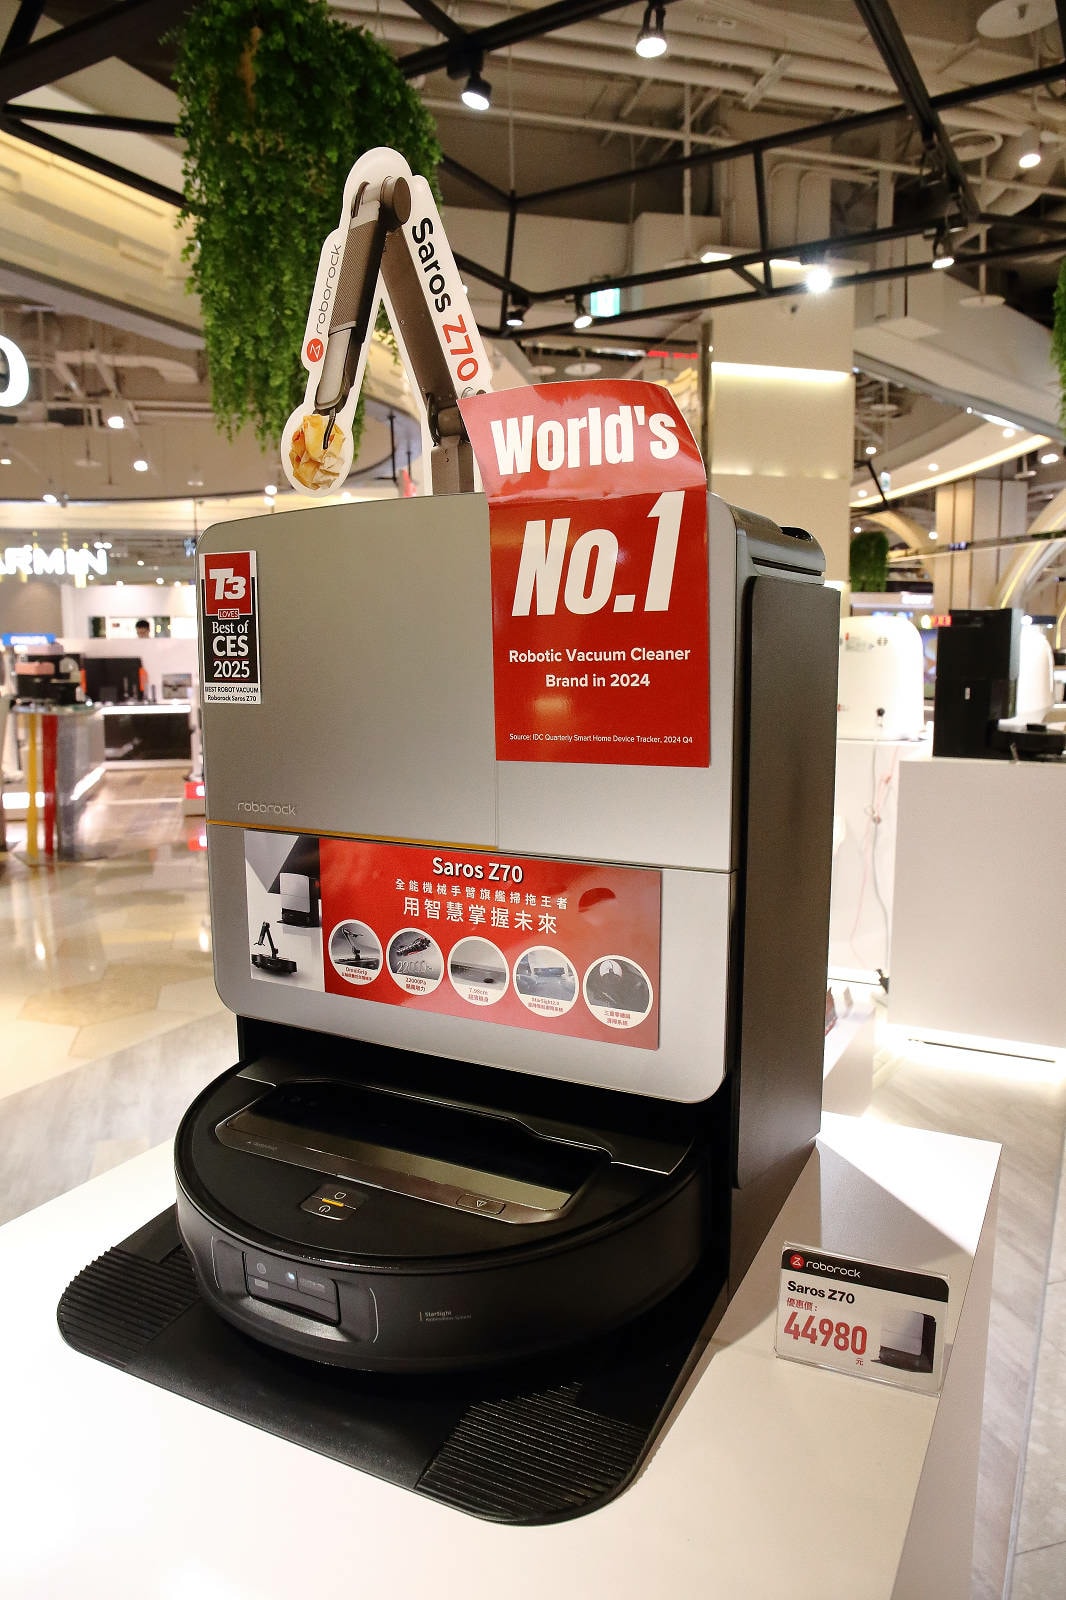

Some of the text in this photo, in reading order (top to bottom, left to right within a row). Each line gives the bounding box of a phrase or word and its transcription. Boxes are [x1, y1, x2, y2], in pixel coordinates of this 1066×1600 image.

[316, 244, 342, 334] roborock
[412, 217, 479, 381] Saros Z70
[490, 405, 680, 476] World's
[0, 547, 107, 575] RMIN
[511, 490, 686, 617] No.1
[209, 568, 247, 600] T3
[218, 610, 239, 619] LOVES
[212, 620, 249, 634] Best of
[212, 635, 249, 657] CES
[509, 647, 691, 663] Robotic Vacuum Cleaner
[213, 660, 250, 678] 2025
[545, 673, 650, 687] Brand in 2024
[509, 733, 532, 741] Source:
[532, 733, 544, 741] IDC
[545, 734, 572, 743] Quarterly
[573, 734, 592, 742] Smart
[593, 735, 612, 743] Home
[613, 735, 635, 743] Device
[663, 736, 681, 744] 2024
[682, 736, 693, 744] Q4
[237, 801, 296, 816] roborock
[432, 857, 524, 883] Saros Z70
[403, 896, 558, 935] 用智慧掌握未來
[806, 1261, 861, 1279] roborock
[787, 1280, 855, 1304] Saros Z70
[784, 1311, 868, 1356] 44980
[855, 1358, 864, 1366] 元
